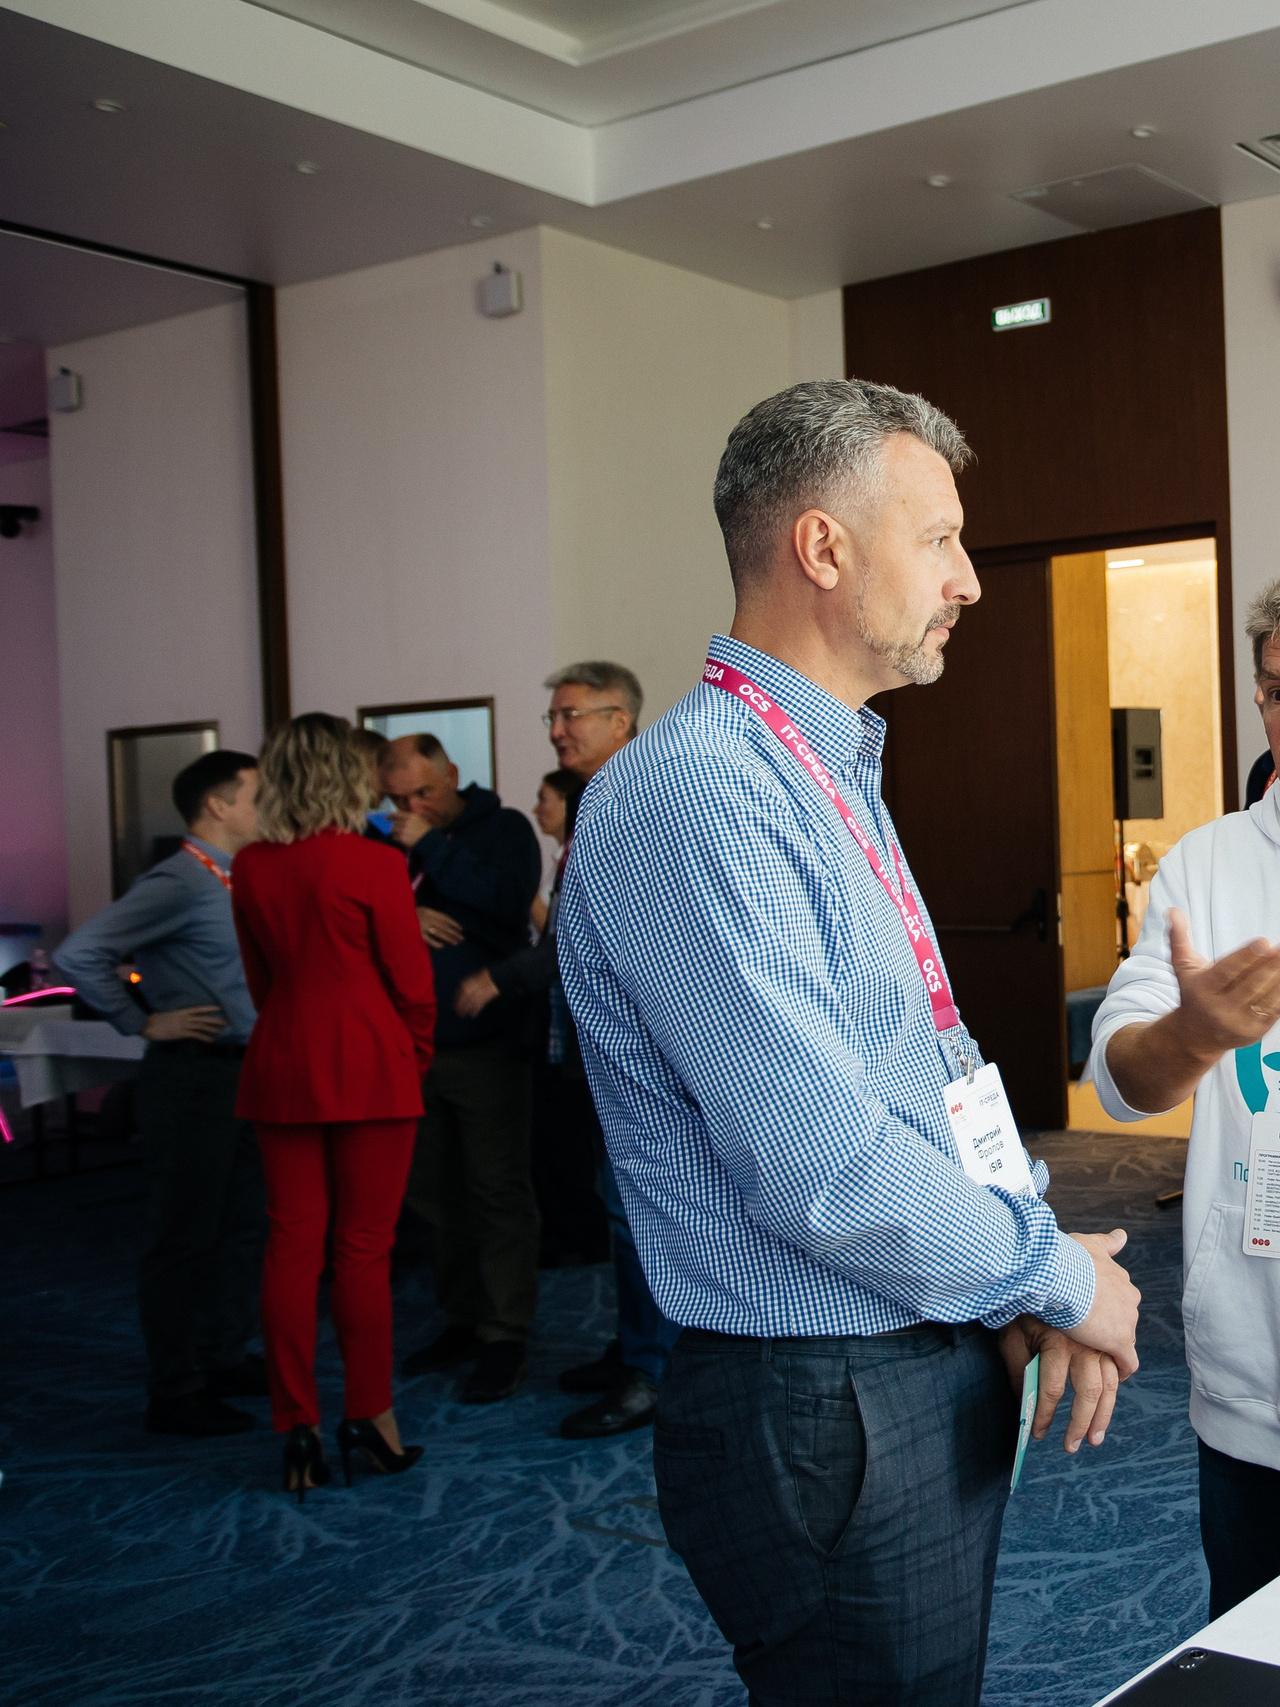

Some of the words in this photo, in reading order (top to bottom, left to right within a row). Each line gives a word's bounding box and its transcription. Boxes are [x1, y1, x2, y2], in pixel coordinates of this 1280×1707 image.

[738, 684, 772, 713] OCS
[846, 816, 870, 850] OCS
[922, 958, 943, 993] OCS
[972, 1124, 1002, 1149] Дмитрий
